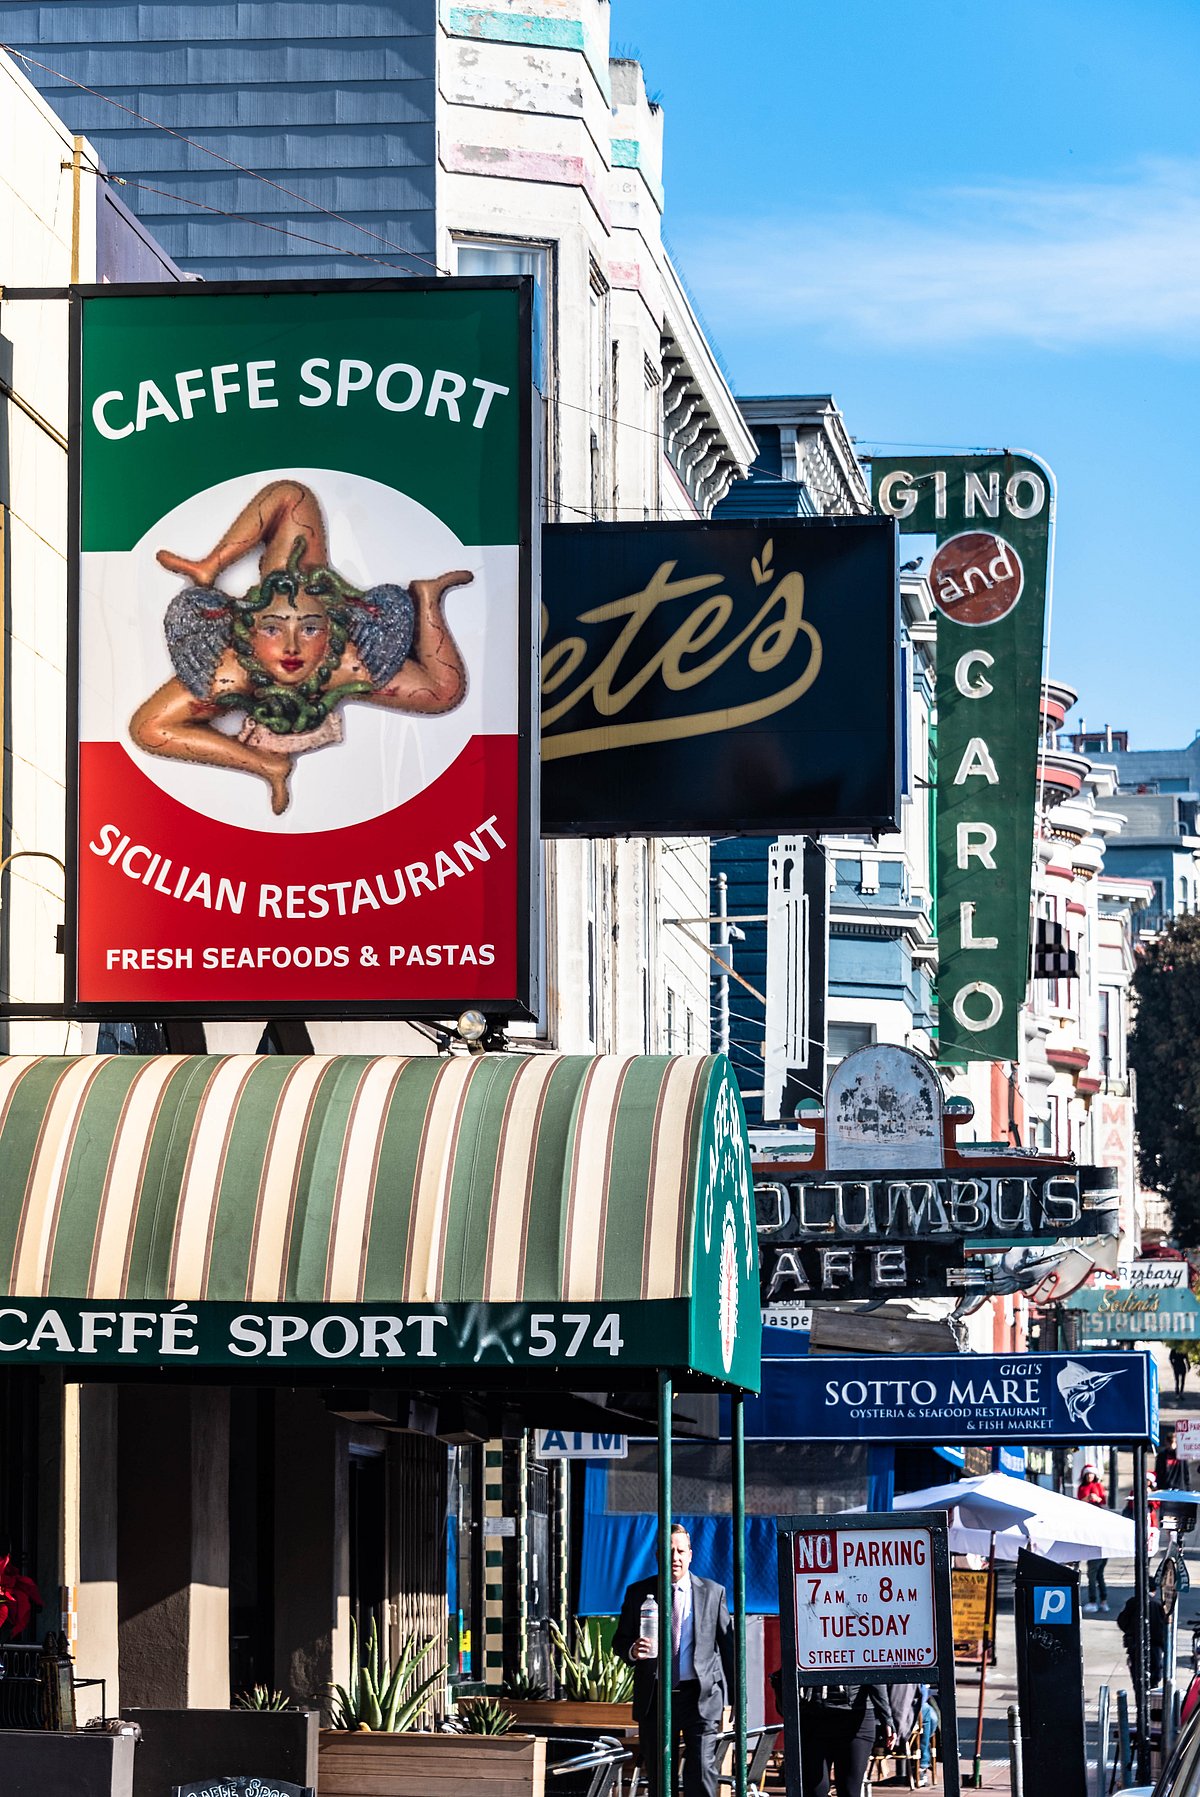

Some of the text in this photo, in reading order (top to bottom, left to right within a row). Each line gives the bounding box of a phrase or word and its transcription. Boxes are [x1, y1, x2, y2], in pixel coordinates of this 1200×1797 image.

[92, 358, 510, 440] CAFFE SPORT
[879, 470, 1045, 519] GINO
[937, 536, 1014, 602] and
[541, 540, 823, 761] ete's
[89, 815, 508, 919] SICILIAN RESTAURANT
[106, 944, 495, 970] FRESH SEAFOODS & PASTAS
[754, 1171, 1080, 1236] OLUMBUS
[760, 1246, 907, 1298] AFE
[1131, 1264, 1183, 1287] arbary
[0, 1303, 199, 1356] CAFFÉ
[228, 1314, 448, 1358] SPORT
[529, 1313, 624, 1357] 574
[1082, 1311, 1198, 1332] ESTAURANT
[1000, 1364, 1042, 1376] GIGI'S
[825, 1379, 1040, 1406] SOTTO MARE
[850, 1407, 1048, 1419] OYSTERIA & SEAFOOD RESTAURANT
[966, 1419, 1054, 1430] & FISH MARKET
[799, 1534, 925, 1569] NO PARKING
[857, 1594, 868, 1603] TO
[820, 1614, 910, 1637] TUESDAY
[809, 1648, 924, 1664] STREET CLEANING
